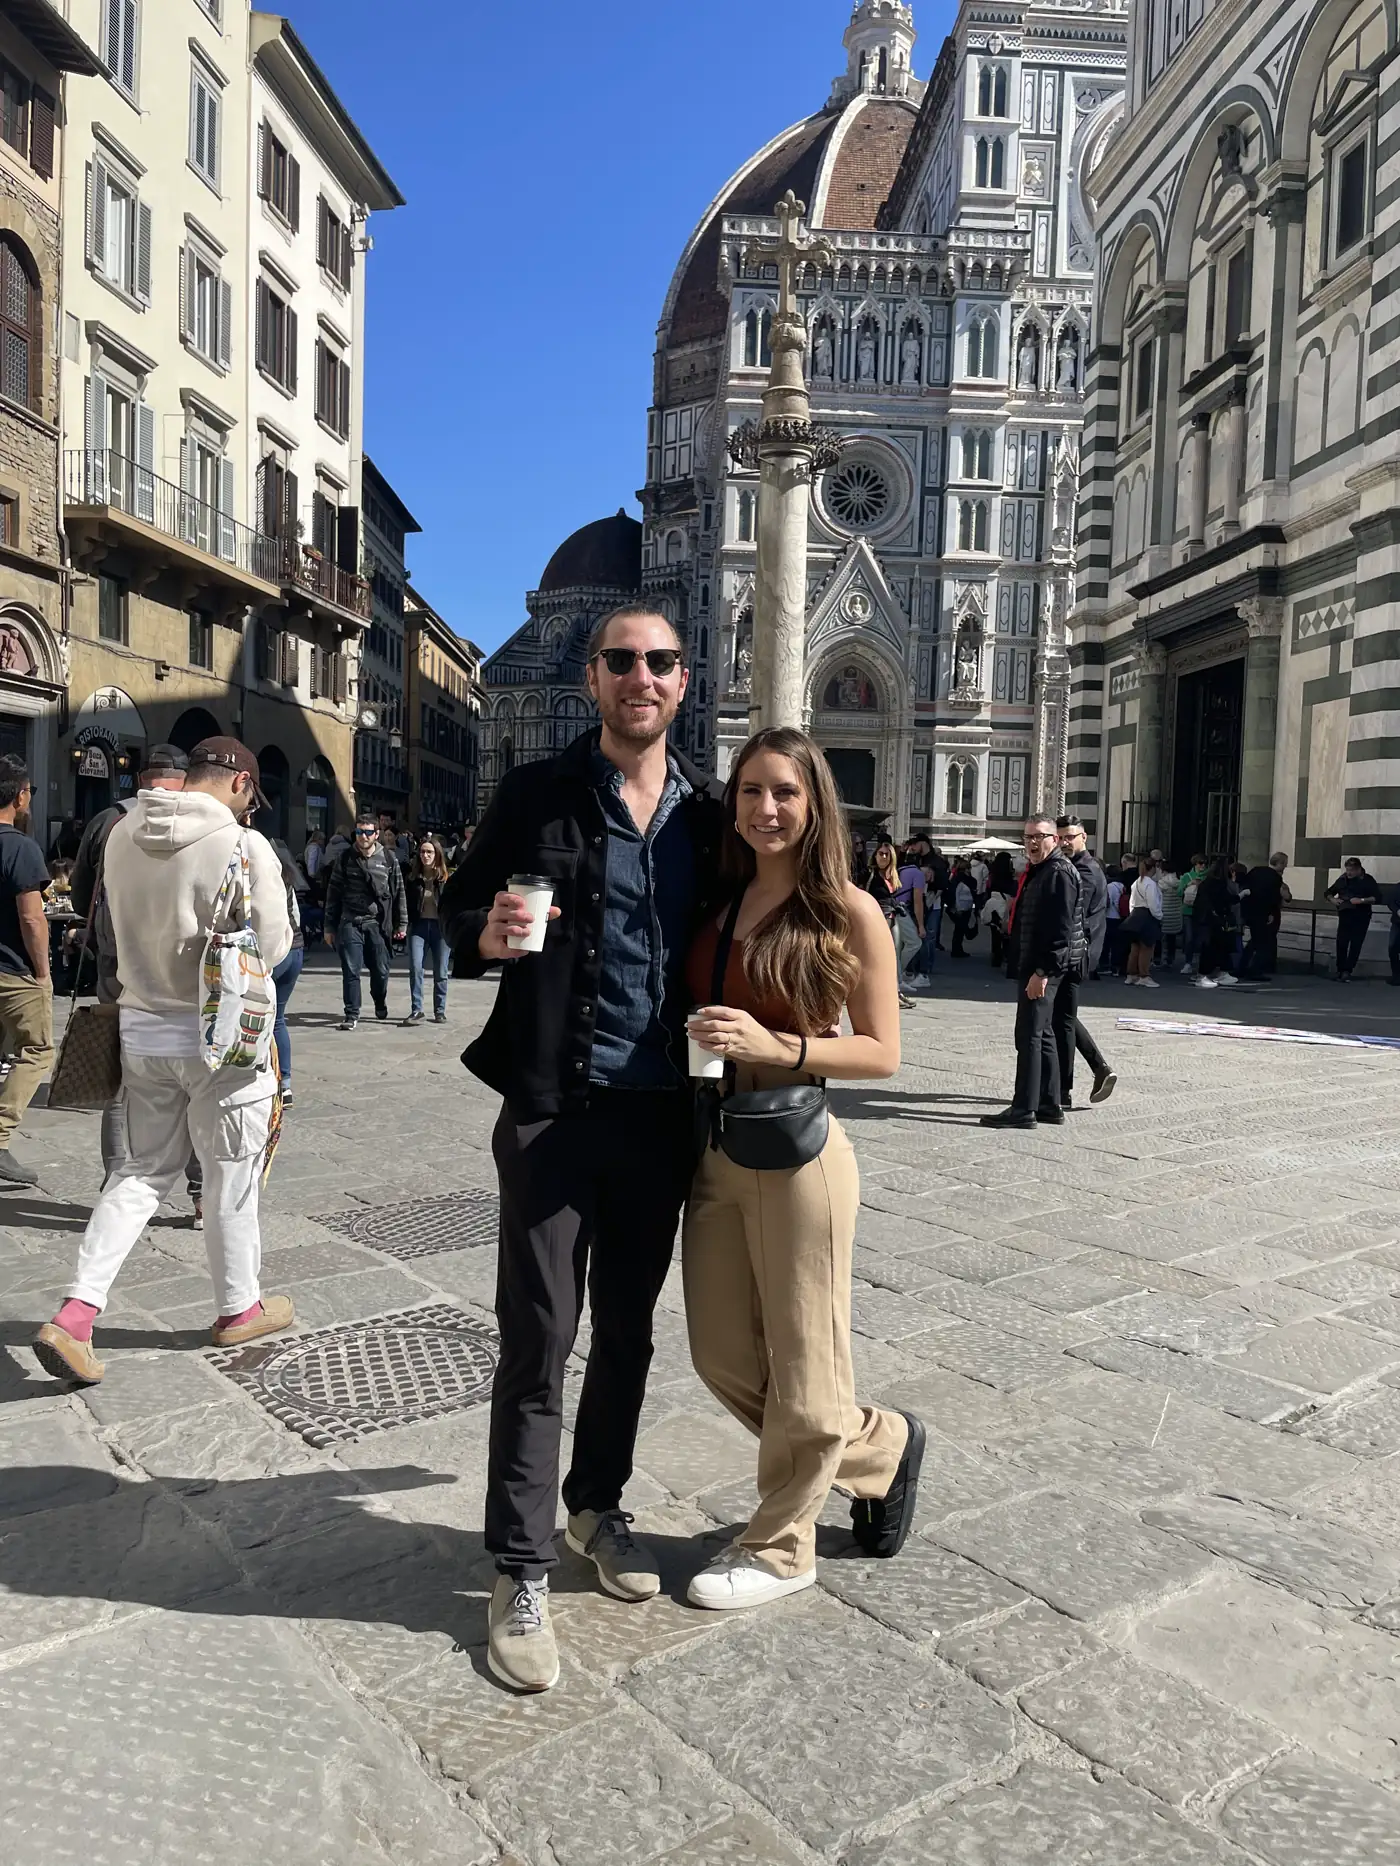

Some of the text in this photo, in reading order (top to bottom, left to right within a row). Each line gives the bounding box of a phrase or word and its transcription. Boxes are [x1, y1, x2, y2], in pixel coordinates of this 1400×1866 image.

[79, 726, 119, 752] RISTORANTE
[88, 758, 100, 768] San
[80, 764, 106, 777] Giovanni
